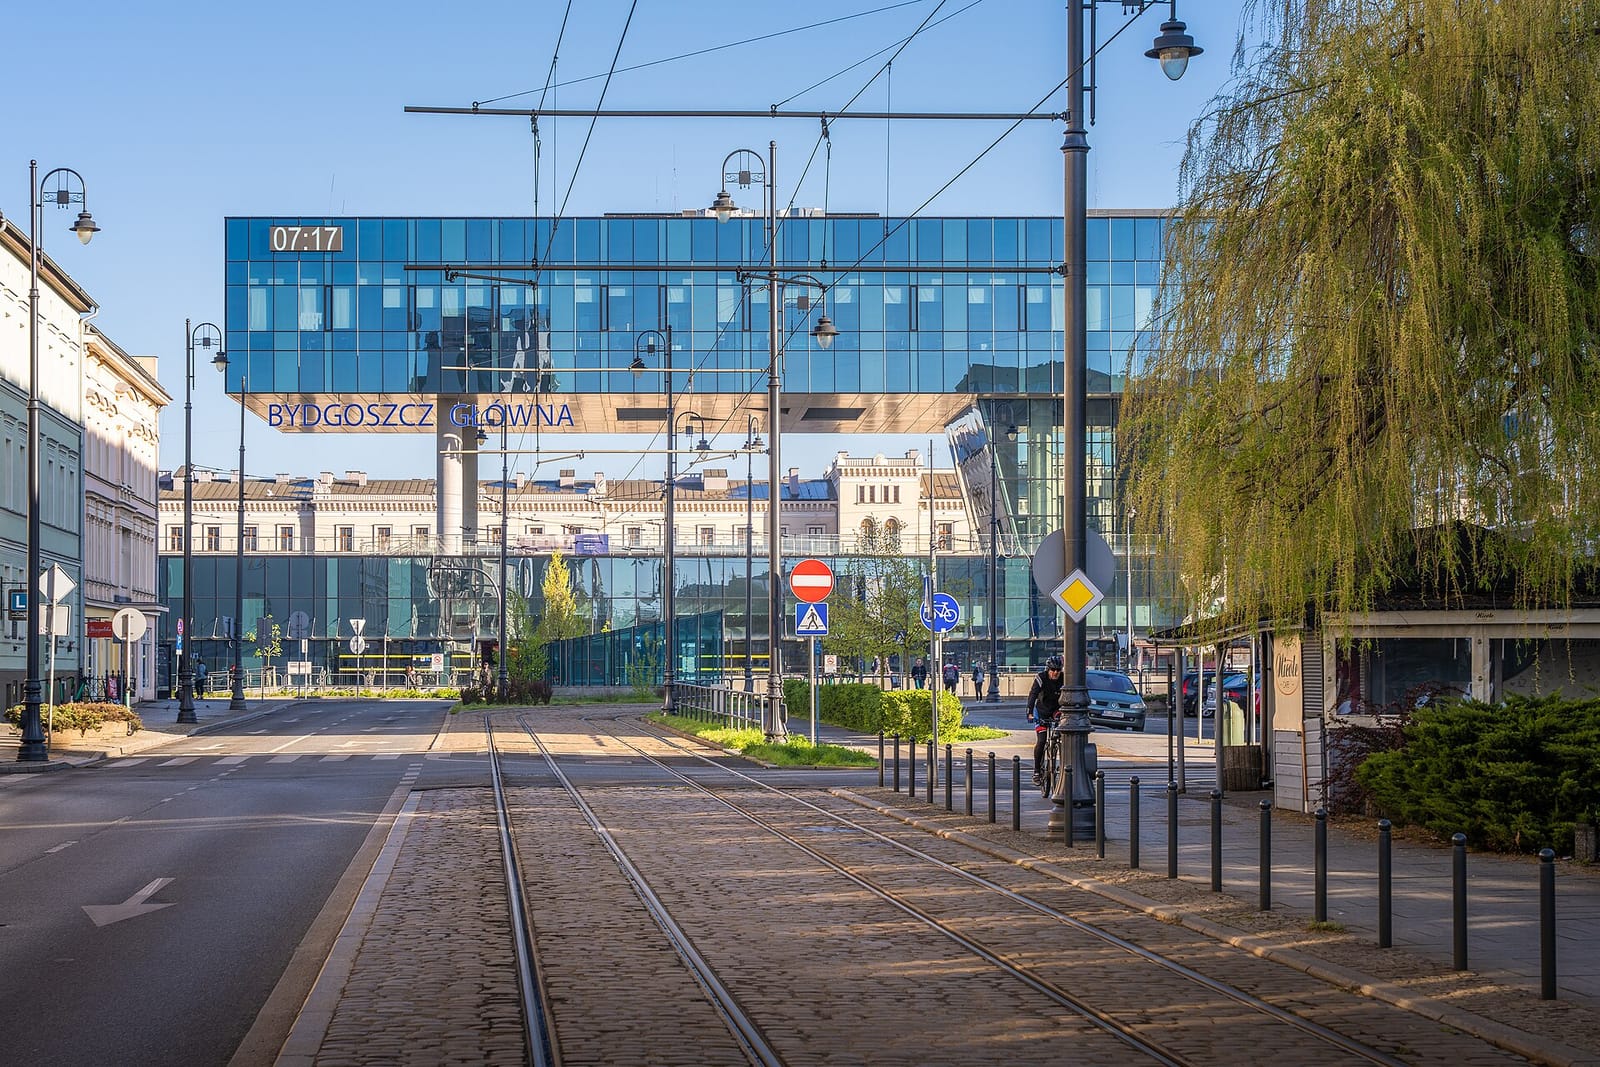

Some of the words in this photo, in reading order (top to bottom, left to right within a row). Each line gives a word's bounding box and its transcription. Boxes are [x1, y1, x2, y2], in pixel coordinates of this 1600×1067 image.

[273, 227, 338, 251] 07:17
[268, 403, 434, 428] BYDGOSZCZ
[449, 398, 575, 428] GŁÓWNA
[15, 595, 26, 608] L
[1275, 653, 1299, 678] Nicole
